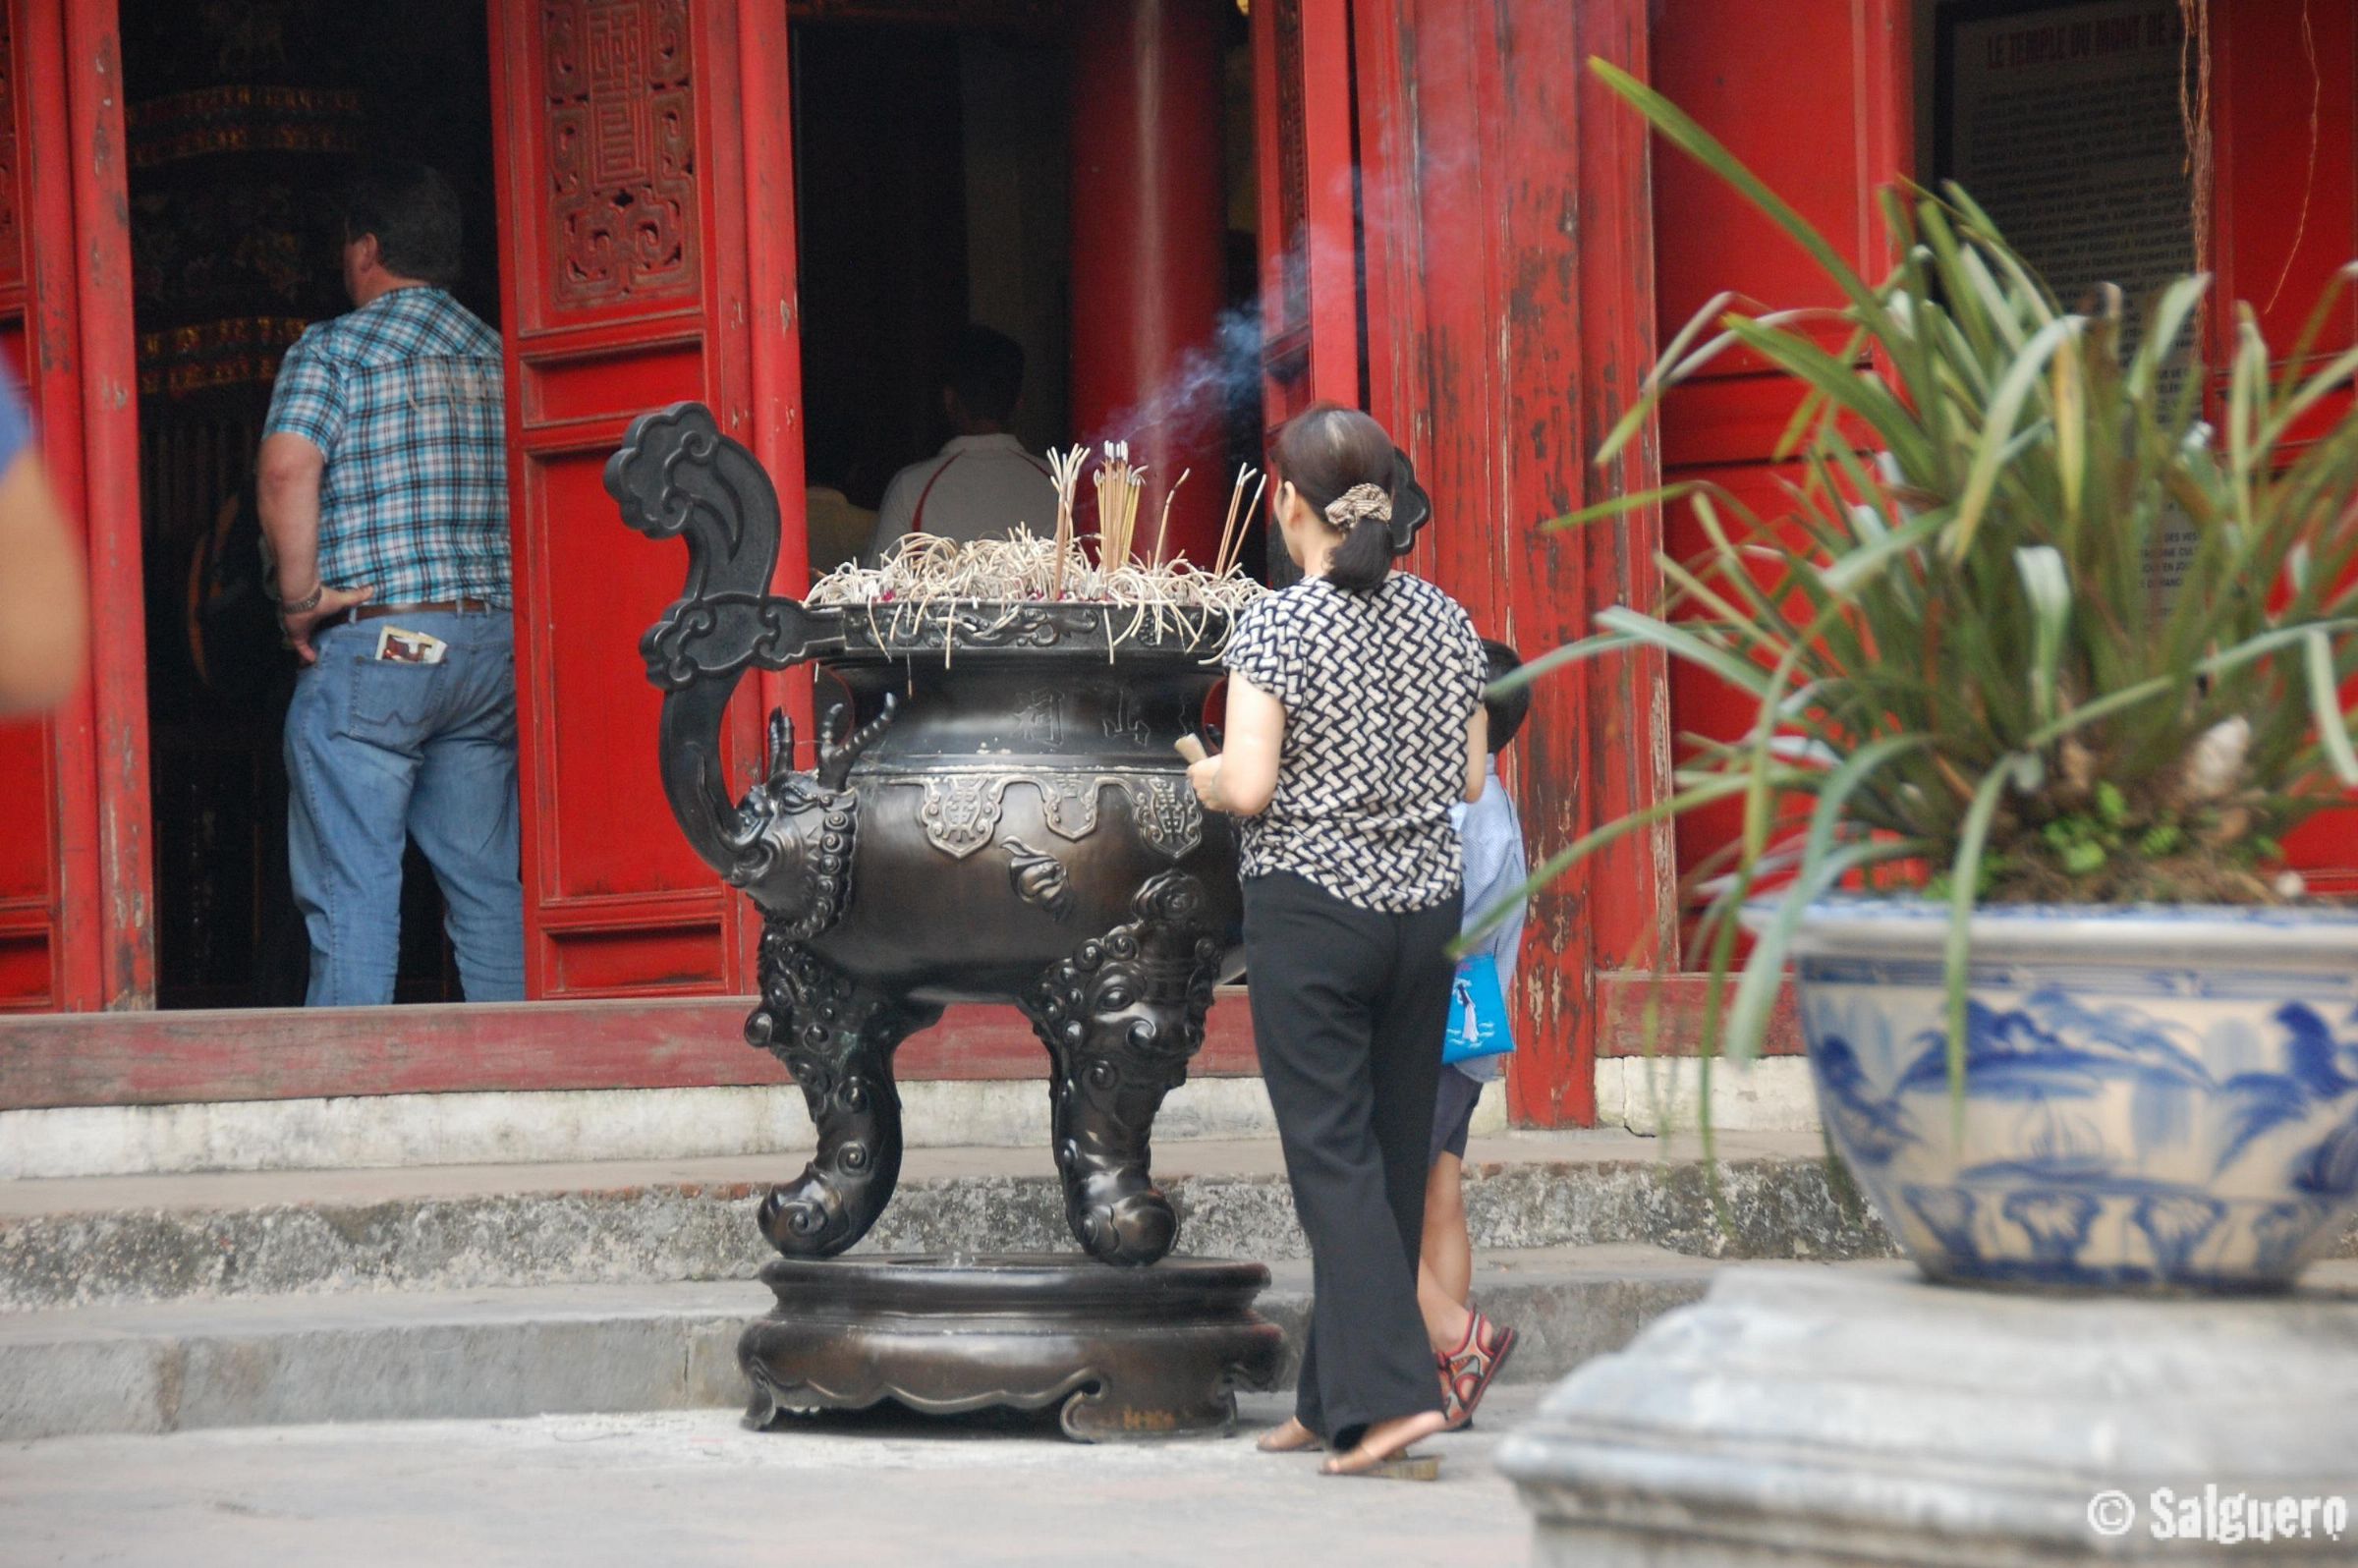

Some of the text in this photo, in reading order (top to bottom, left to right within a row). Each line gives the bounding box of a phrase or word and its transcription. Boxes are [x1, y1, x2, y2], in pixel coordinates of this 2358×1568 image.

[1988, 33, 2004, 69] LE
[2009, 25, 2065, 66] TEMPLE
[2071, 21, 2092, 58] DU
[2096, 14, 2141, 54] MONT
